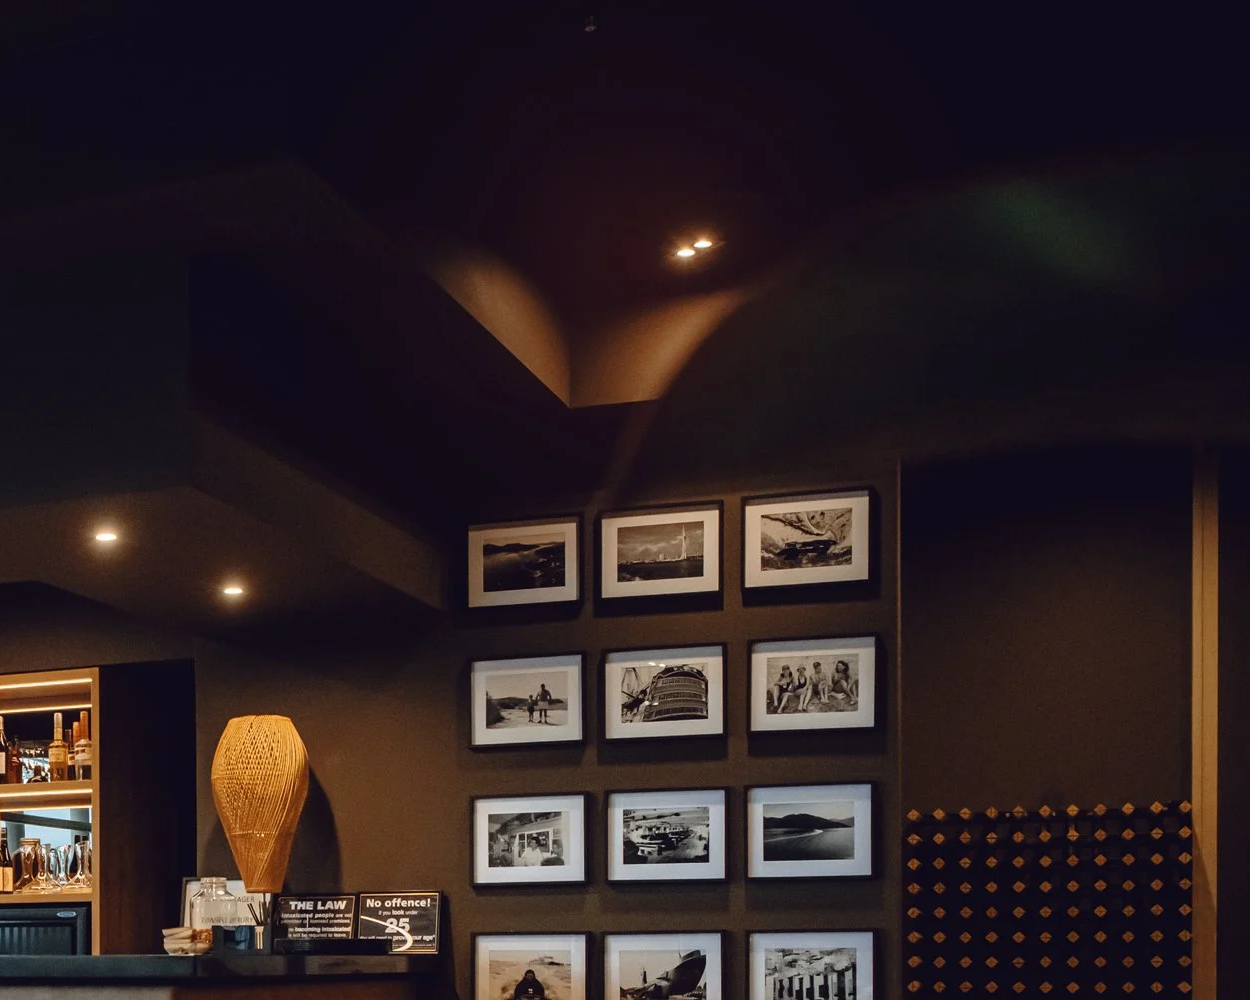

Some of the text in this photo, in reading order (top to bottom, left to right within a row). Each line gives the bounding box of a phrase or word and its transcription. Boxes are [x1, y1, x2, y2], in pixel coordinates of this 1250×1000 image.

[289, 900, 347, 910] THE LAW
[366, 898, 431, 907] No offence!
[384, 917, 411, 933] 25
